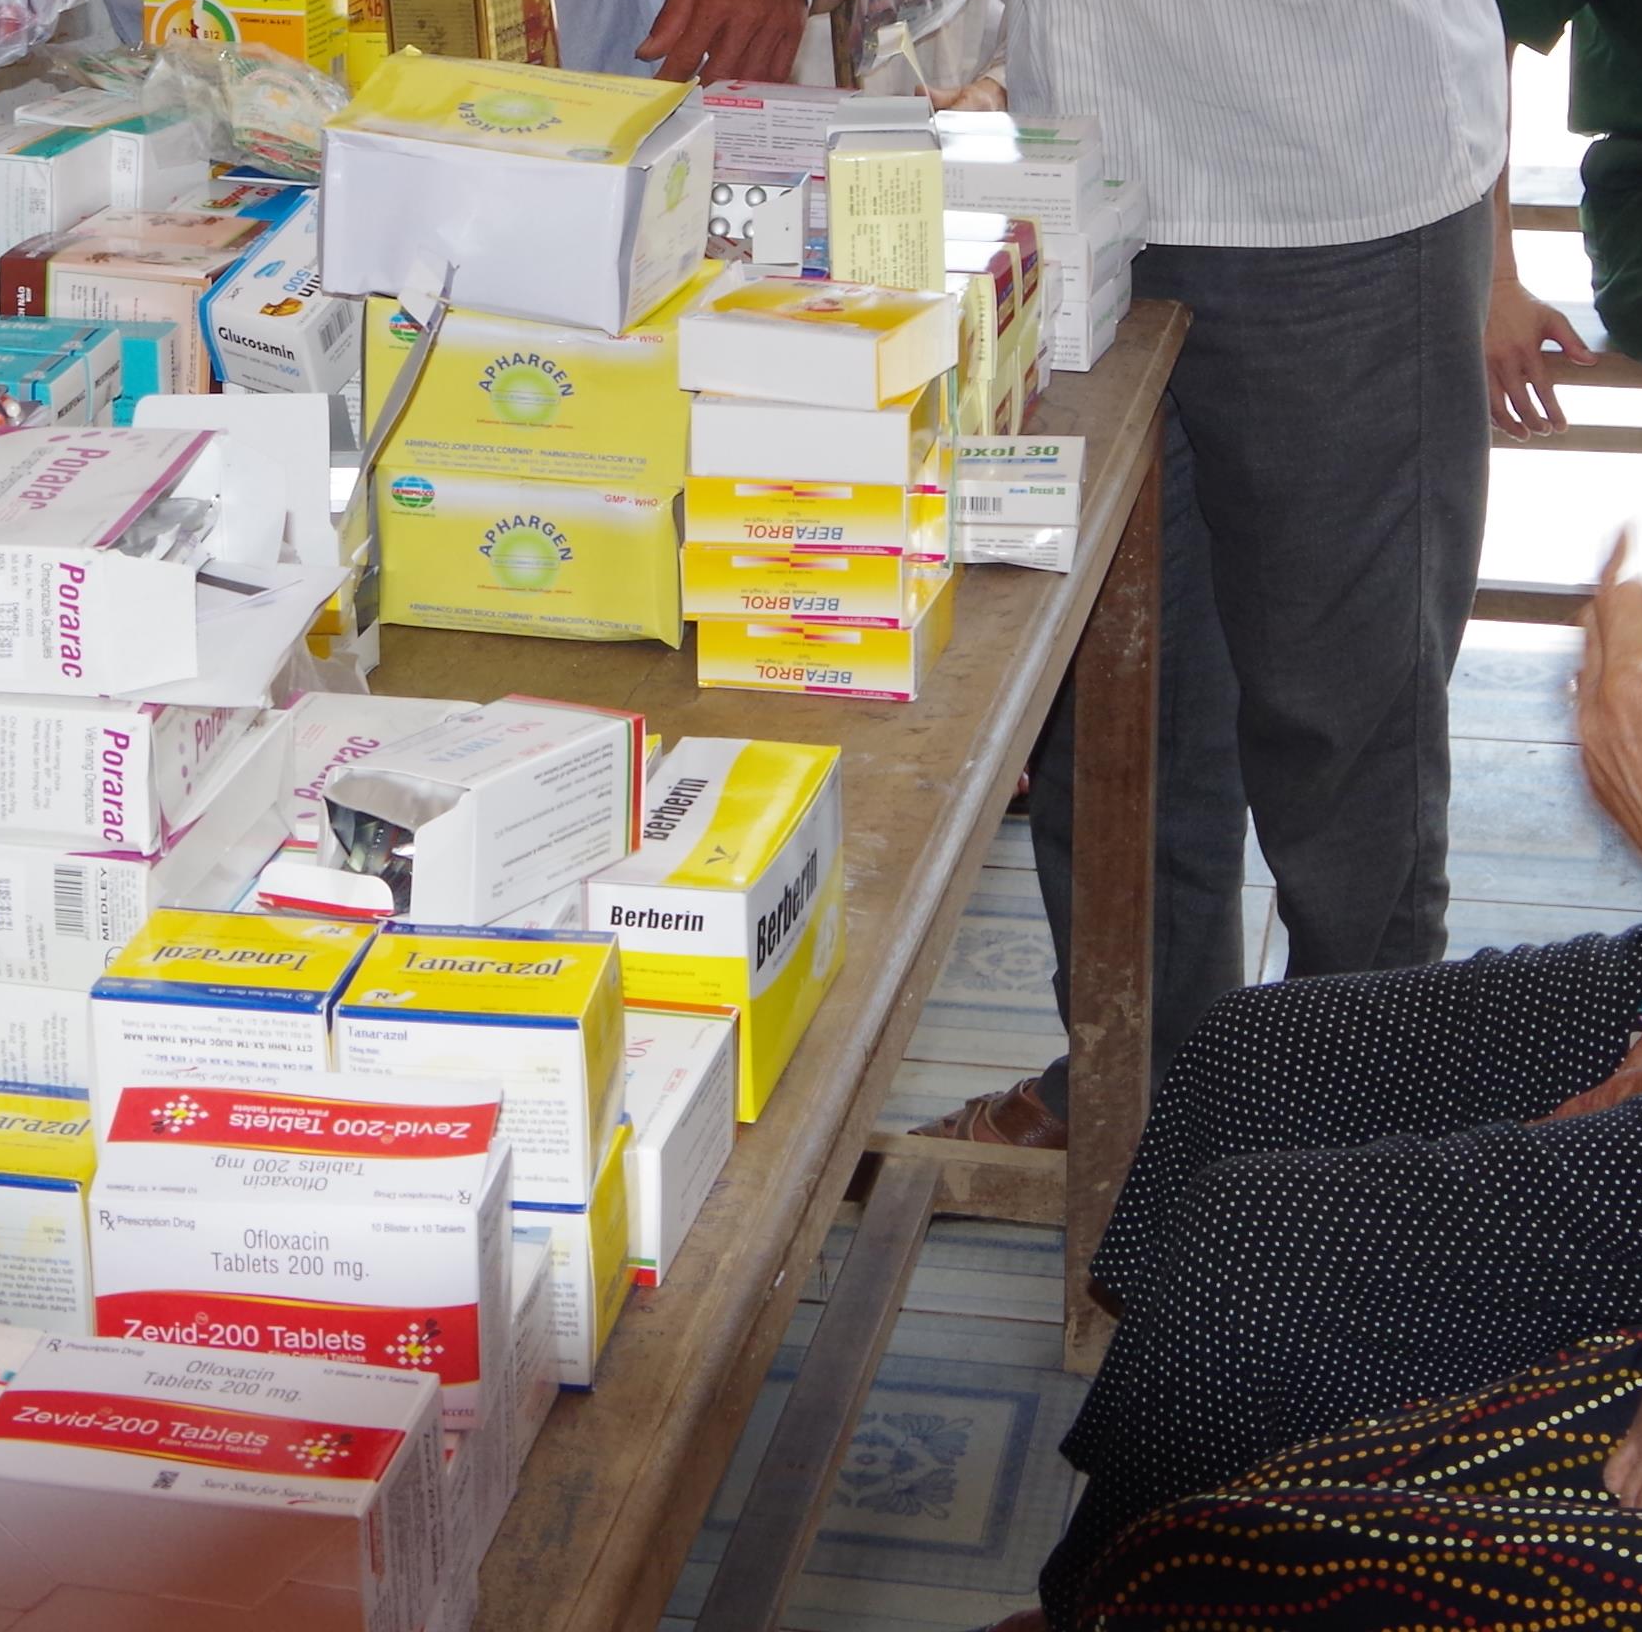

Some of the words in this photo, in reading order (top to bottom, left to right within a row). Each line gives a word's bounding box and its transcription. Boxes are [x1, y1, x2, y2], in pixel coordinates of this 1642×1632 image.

[458, 103, 563, 134] APHARGEN
[217, 325, 295, 362] Glucosamin
[638, 334, 664, 343] WHO
[479, 352, 575, 398] APHARGEN
[961, 446, 1015, 456] oxol
[1026, 446, 1059, 456] 30
[605, 494, 627, 505] GMP
[634, 497, 658, 507] WHO
[479, 515, 574, 562] APHARGEN
[743, 525, 843, 540] BEFABROL
[40, 563, 53, 617] Omeprazole
[740, 596, 839, 611] BEFABROL
[59, 562, 85, 678] Porarac
[43, 619, 54, 659] Capsules
[754, 665, 852, 684] BEFABROL
[103, 728, 130, 843] Porarac
[643, 776, 710, 842] Berberin
[610, 904, 705, 932] Berberin
[756, 848, 819, 973] Berberin
[152, 946, 308, 972] Tanarazol
[405, 950, 563, 978] Tanarazol
[347, 1024, 408, 1042] Tanarazol
[233, 1105, 267, 1114] Tablets
[229, 1113, 324, 1134] Tablets
[332, 1119, 471, 1139] Zevid-200
[210, 1155, 245, 1170] mg.
[254, 1159, 290, 1172] 200
[299, 1160, 365, 1176] Tablets
[243, 1175, 328, 1191] Ofloxacin
[374, 1190, 396, 1199] Drug
[399, 1192, 453, 1201] Prescription
[117, 1214, 171, 1230] Prescription
[172, 1216, 196, 1231] Drug
[243, 1228, 330, 1252] Ofloxacin
[211, 1251, 281, 1274] Tablets
[287, 1253, 327, 1275] 200
[334, 1257, 370, 1281] mg.
[123, 1317, 259, 1348] Zevid-200
[267, 1323, 367, 1352] Tablets
[64, 1342, 120, 1356] Prescription
[122, 1345, 145, 1358] Drug
[185, 1359, 276, 1382] Ofloxacin
[143, 1371, 213, 1391] Tablets
[219, 1378, 261, 1396] 200
[267, 1385, 303, 1403] mg.
[13, 1406, 159, 1436] Zevid-200
[169, 1422, 270, 1448] Tablets
[159, 1436, 183, 1448] Film
[185, 1439, 223, 1452] Coated
[224, 1442, 262, 1456] Tablets
